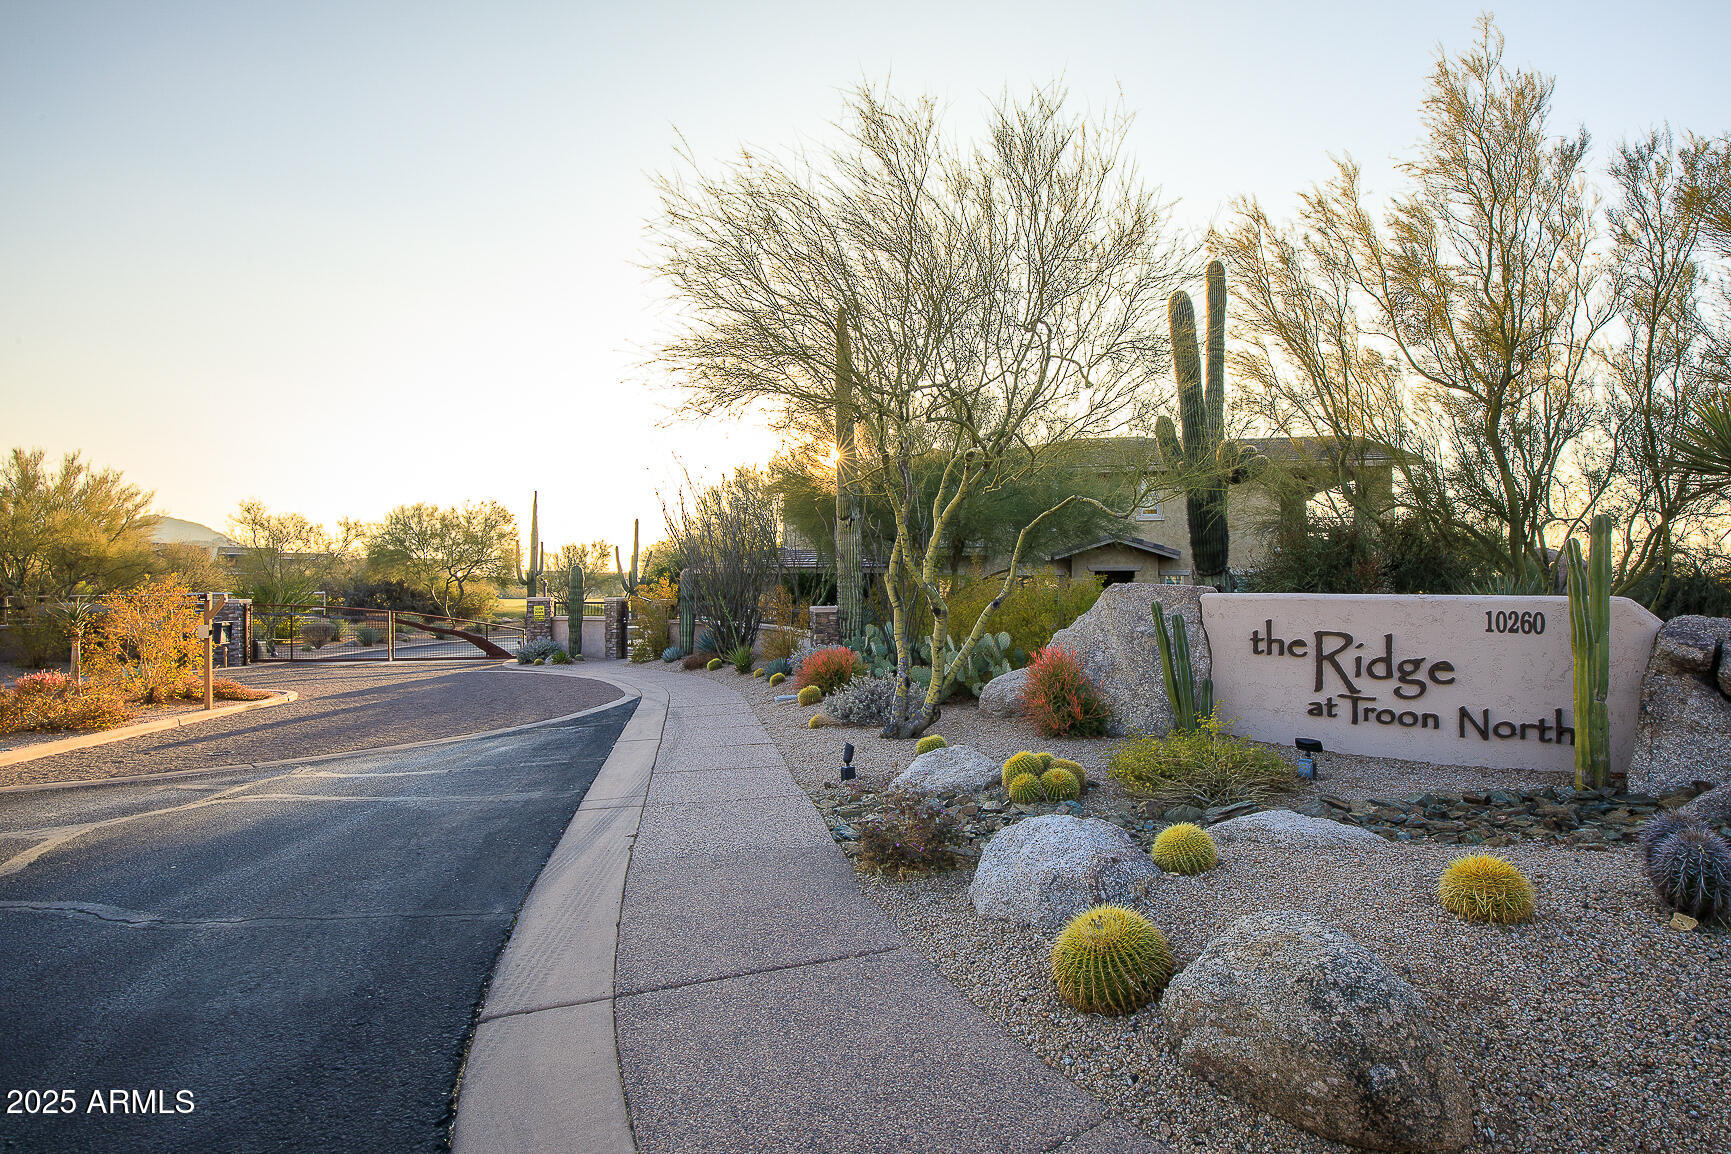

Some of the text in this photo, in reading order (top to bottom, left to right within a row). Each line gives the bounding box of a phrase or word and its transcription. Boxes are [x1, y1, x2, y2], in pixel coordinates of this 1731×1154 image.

[1485, 610, 1546, 635] 10260
[1250, 619, 1456, 699] the Ridge
[1307, 693, 1575, 746] at Troon North
